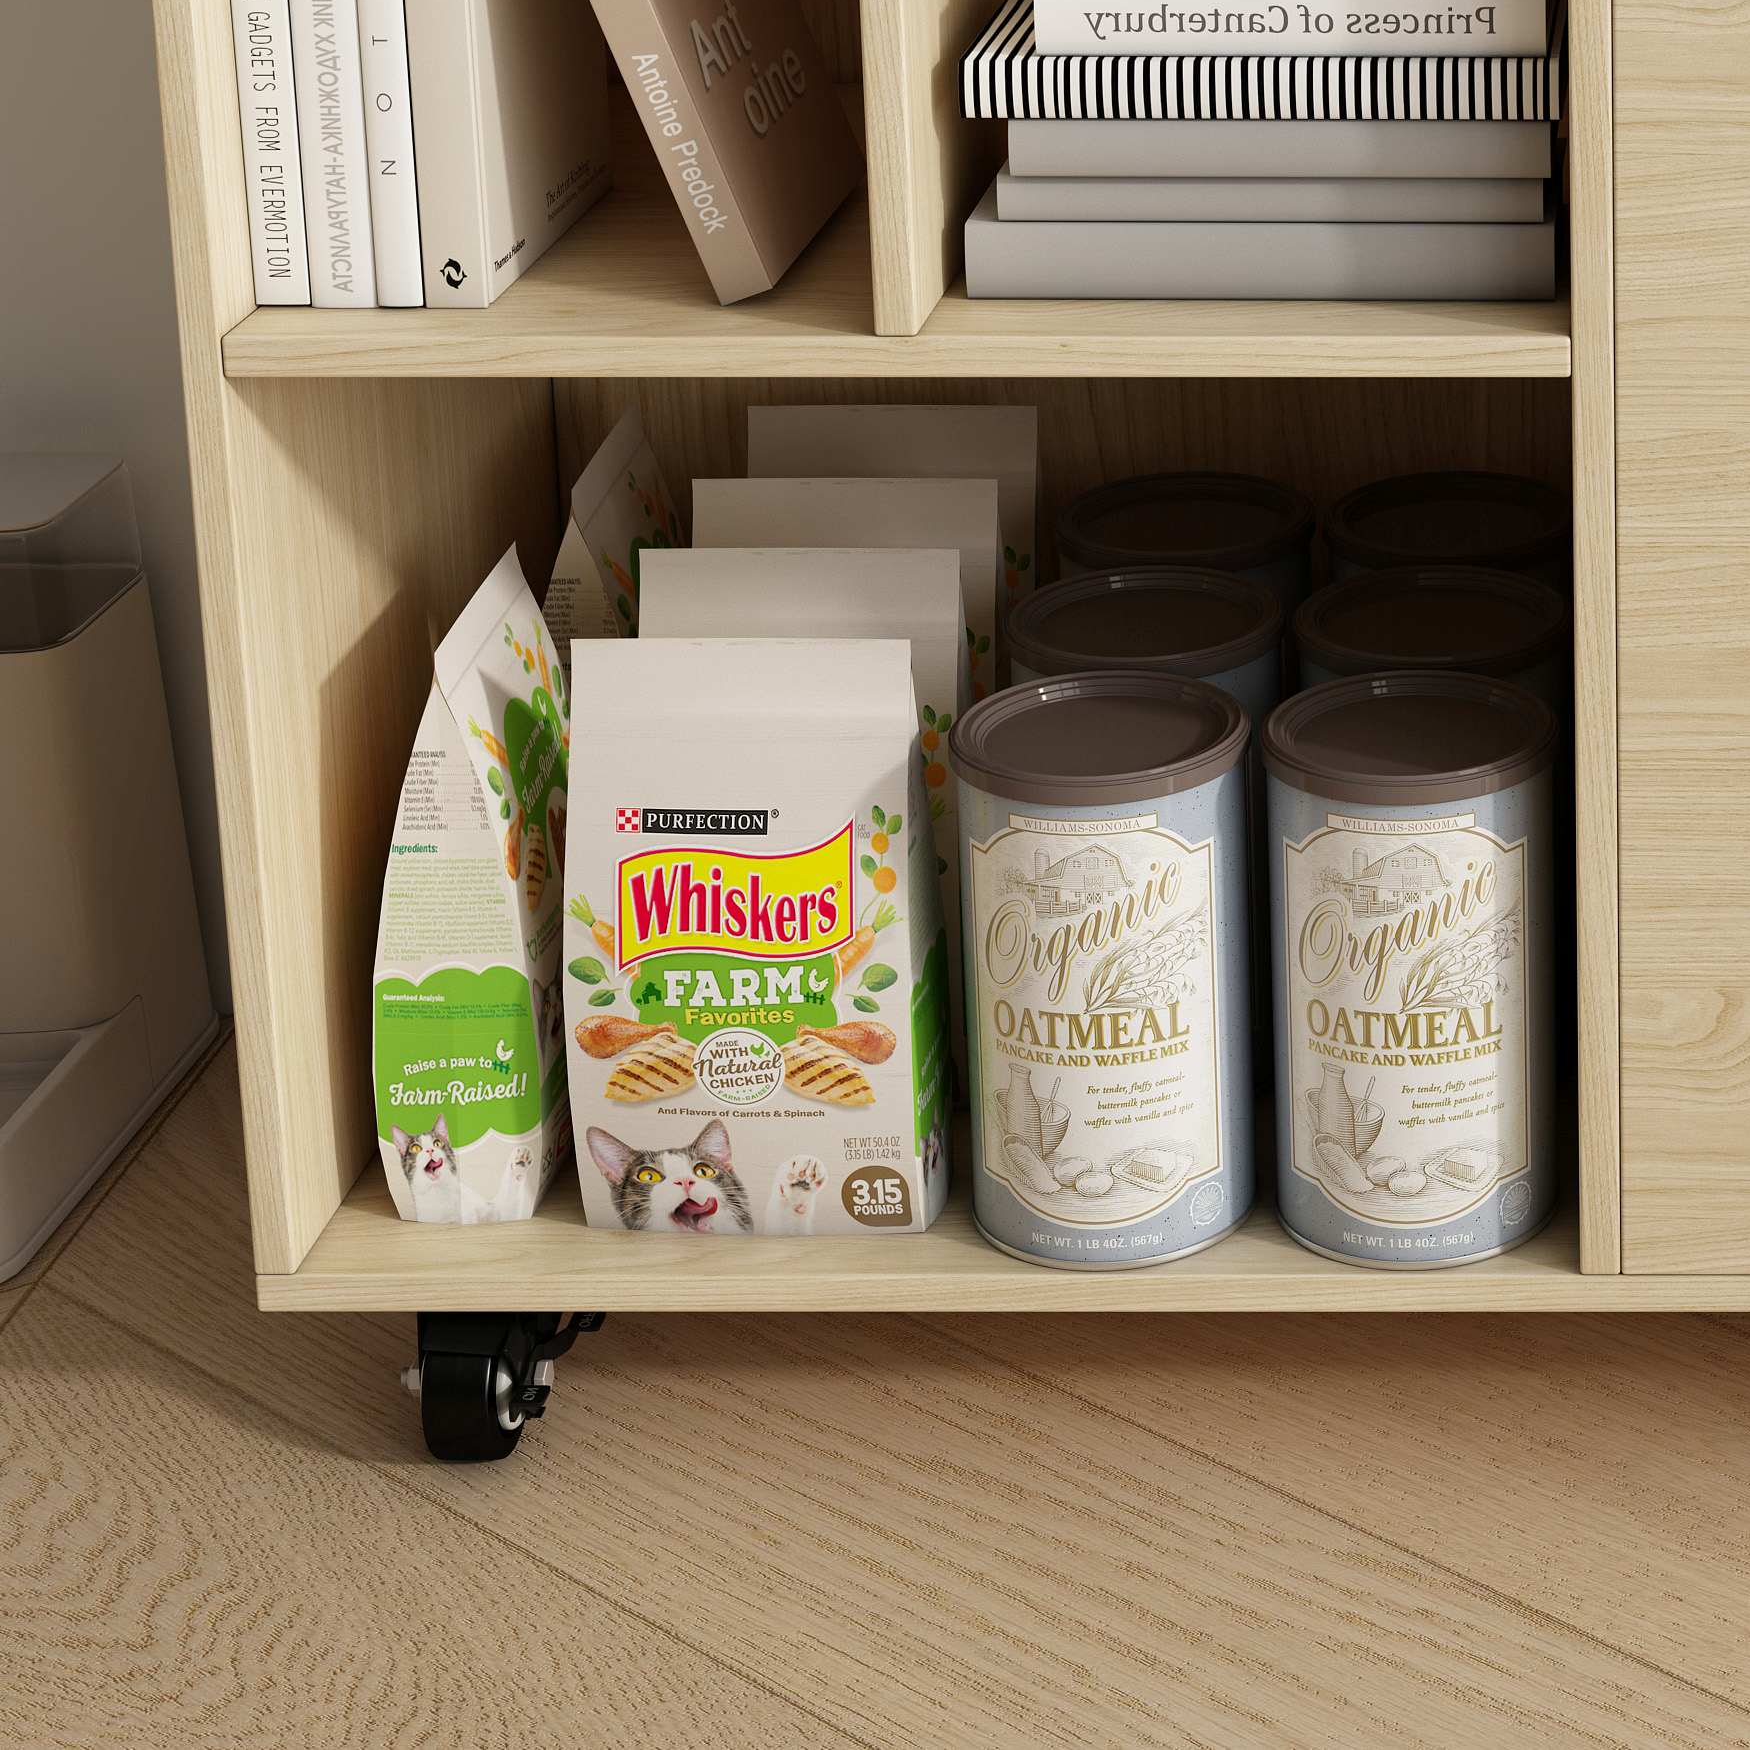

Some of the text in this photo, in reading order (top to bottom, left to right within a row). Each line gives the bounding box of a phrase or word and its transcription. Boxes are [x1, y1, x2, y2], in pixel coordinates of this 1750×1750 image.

[247, 11, 276, 92] GADGETS
[743, 47, 806, 138] oine
[255, 107, 281, 152] FROM
[632, 53, 729, 235] Antoine Predock
[259, 165, 292, 279] EVERMOTION
[646, 812, 766, 831] PURFECTION
[1023, 819, 1141, 833] WILLIAMS-SONOMA
[1342, 818, 1460, 833] WILLIAMS-SONOMA
[391, 843, 438, 856] Ingredients:
[629, 861, 838, 944] Whiskers
[985, 861, 1183, 1005] Organic
[1299, 859, 1497, 1005] Organic
[663, 965, 805, 1007] FARM
[685, 1007, 795, 1026] Favorites
[993, 1000, 1191, 1051] OATMEAL
[1306, 998, 1504, 1051] OATMEAL
[710, 1047, 749, 1060] WITH
[715, 1040, 740, 1048] MADE
[996, 1038, 1191, 1067] PANCAKE AND WAFFLE MIX
[1308, 1038, 1503, 1067] PANCAKE AND WAFFLE MIX
[403, 1056, 492, 1076] Raise a paw to
[692, 1052, 783, 1078] Natural
[389, 1073, 527, 1106] Farm-Raised!
[709, 1073, 775, 1089] CHICKEN
[1087, 1085, 1100, 1095] For
[1103, 1083, 1128, 1094] tender,
[1128, 1080, 1152, 1095] fluffy
[1401, 1085, 1415, 1094] For
[1417, 1084, 1442, 1094] tender,
[1442, 1080, 1466, 1094] fluffy
[1097, 1097, 1138, 1110] buttermilk
[1140, 1093, 1171, 1108] pancakes
[1412, 1097, 1452, 1110] buttermilk
[1454, 1093, 1485, 1108] pancakes
[657, 1107, 677, 1115] And
[679, 1108, 717, 1117] Flavors
[719, 1109, 729, 1117] of
[732, 1110, 771, 1118] Carrots
[784, 1109, 825, 1118] Spinach
[1084, 1117, 1112, 1129] waffles
[1114, 1114, 1131, 1125] with
[1135, 1110, 1160, 1123] vanilla
[1163, 1106, 1177, 1116] and
[1398, 1116, 1426, 1129] waffles
[1428, 1113, 1446, 1124] with
[1448, 1109, 1473, 1122] vanilla
[1475, 1105, 1489, 1116] and
[843, 1136, 901, 1149] NET WT 50.4 OZ
[845, 1149, 861, 1161] (3.15
[862, 1149, 875, 1161] LB)
[891, 1149, 901, 1160] kg
[851, 1178, 902, 1205] 3.15
[854, 1204, 903, 1216] POUNDS
[1032, 1232, 1052, 1245] NET
[1054, 1235, 1073, 1248] WT.
[1077, 1239, 1082, 1249] 1
[1086, 1239, 1100, 1249] LB
[1130, 1231, 1163, 1248] (567g)
[1343, 1231, 1363, 1245] NET
[1365, 1235, 1385, 1248] WT.
[1389, 1238, 1394, 1248] 1
[1398, 1238, 1412, 1249] LB
[1442, 1231, 1473, 1247] (567g)
